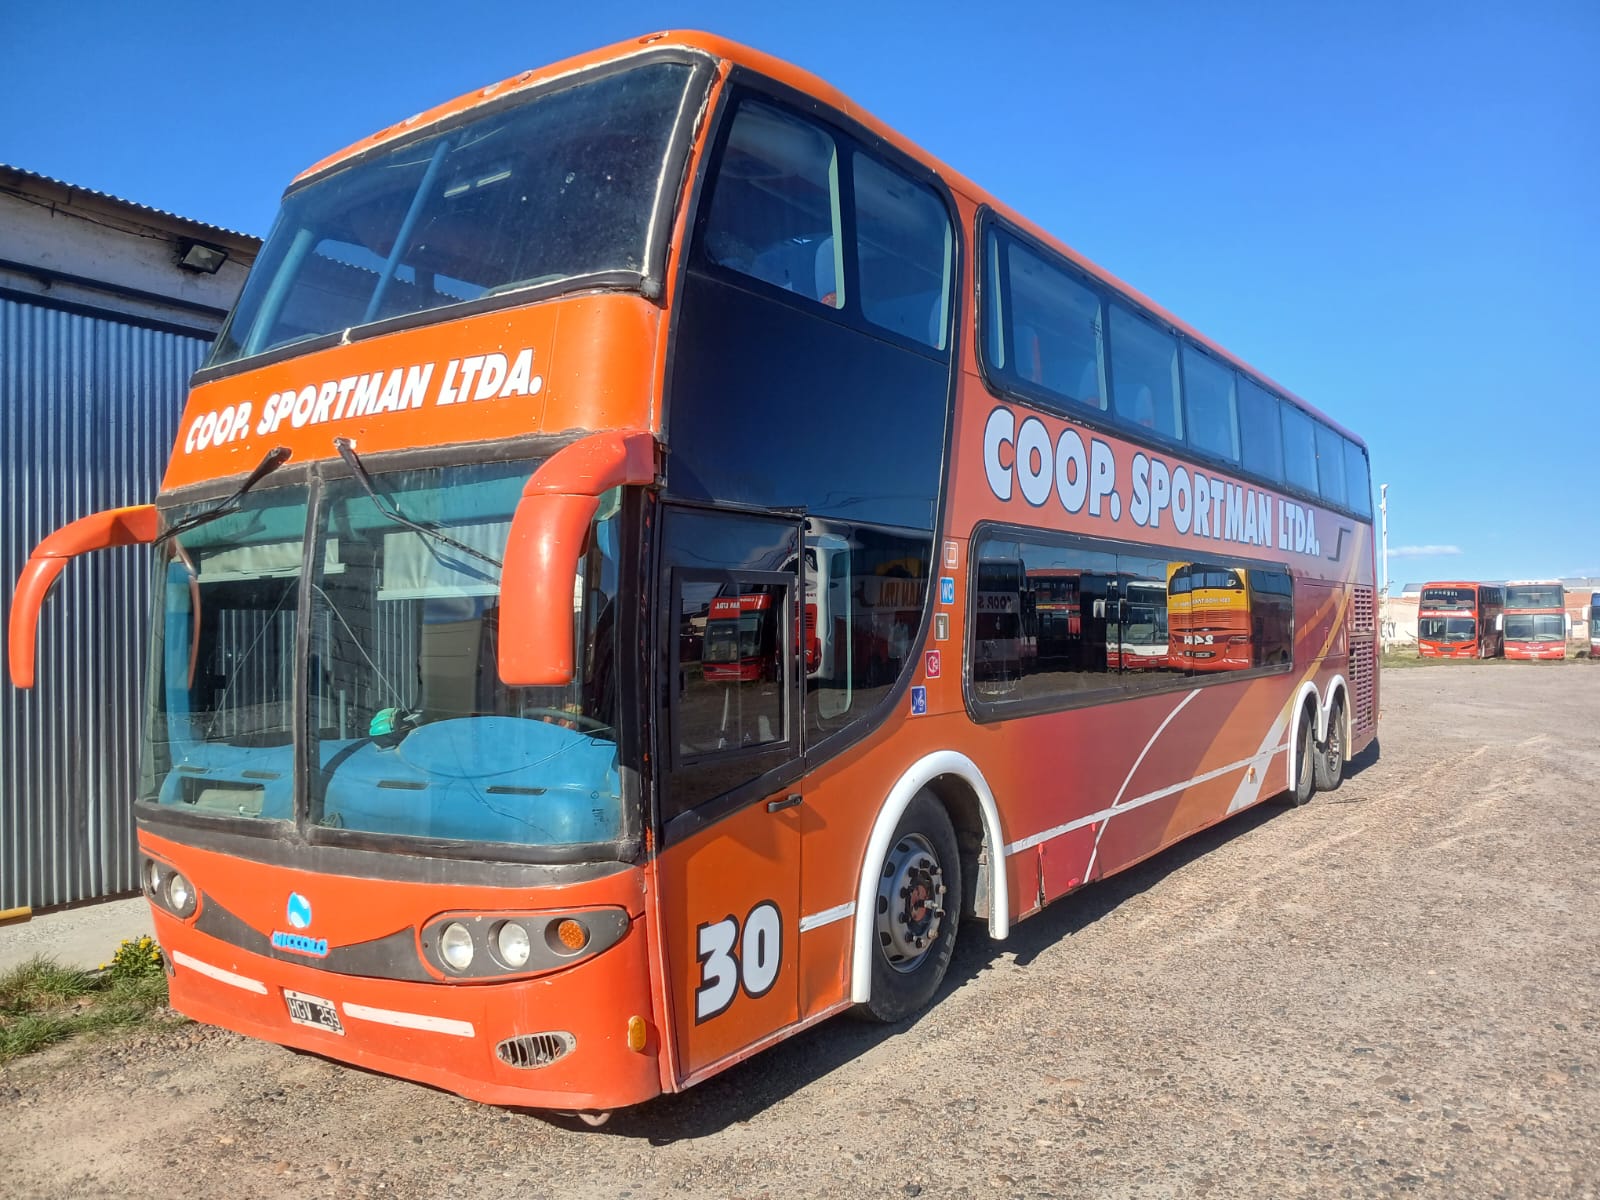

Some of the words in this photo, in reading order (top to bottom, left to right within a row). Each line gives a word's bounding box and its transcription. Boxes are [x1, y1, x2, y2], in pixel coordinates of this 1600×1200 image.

[184, 401, 251, 454] COOP.
[256, 363, 435, 436] SPORTMAN
[436, 348, 543, 407] LTDA.
[983, 405, 1122, 521] COOP.
[1129, 452, 1273, 548] SPORTMAN
[1277, 499, 1320, 557] LTDA.
[941, 582, 953, 601] WC
[288, 998, 313, 1021] HGV
[316, 1005, 341, 1028] 259
[695, 899, 784, 1026] 30
